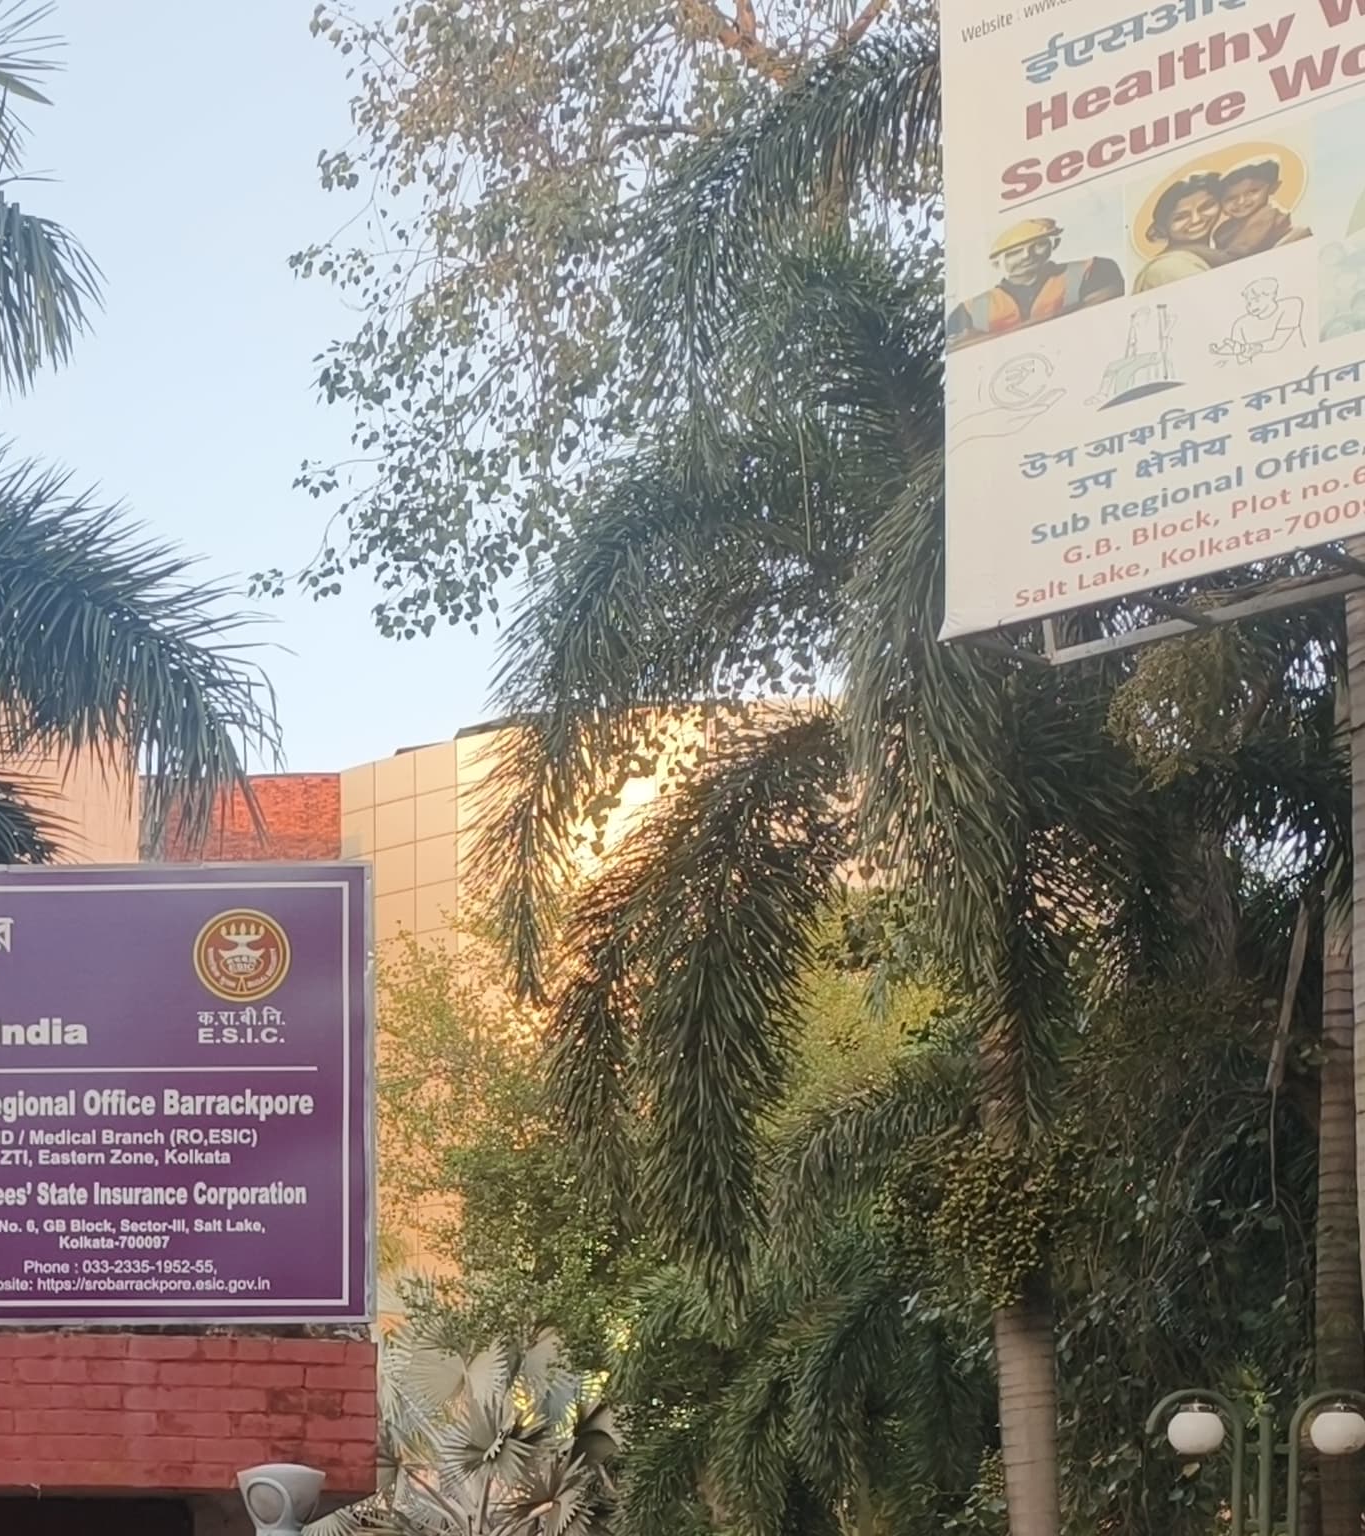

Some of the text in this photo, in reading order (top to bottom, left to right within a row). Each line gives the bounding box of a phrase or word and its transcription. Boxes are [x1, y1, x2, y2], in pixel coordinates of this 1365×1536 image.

[961, 12, 1014, 43] Website
[1026, 13, 1296, 141] Healthy
[1000, 90, 1246, 201] Secure
[1019, 446, 1079, 479] উপ
[1068, 434, 1233, 499] उप क्षेत्रीय
[1030, 465, 1244, 545] Sub Regional
[1063, 536, 1121, 565] G.B.
[1132, 508, 1220, 547] Block,
[1231, 487, 1292, 519] Plot
[1015, 560, 1150, 608] Salt Lake,
[197, 1026, 286, 1044] E.S.I.C.
[83, 1088, 157, 1117] Office
[164, 1088, 315, 1122] Barrackpore
[18, 1129, 25, 1146] /
[29, 1128, 97, 1146] Medical
[102, 1128, 165, 1146] Branch
[170, 1127, 258, 1148] (RO,ESIC)
[0, 1148, 232, 1168] ZTI, Eastern Zone, Kolkata
[37, 1181, 89, 1207] State
[94, 1181, 188, 1206] Insurance
[193, 1180, 308, 1211] Corporation
[26, 1218, 40, 1235] 6,
[43, 1218, 67, 1233] GB
[70, 1218, 117, 1235] Block,
[120, 1218, 190, 1235] Sector-III,
[193, 1218, 223, 1233] Salt
[226, 1218, 266, 1235] Lake,
[59, 1235, 170, 1250] Kolkata-700097
[24, 1259, 218, 1276] Phone 033-2335-1952-55,
[37, 1275, 271, 1294] https://srobarrackpore.esic.gov.in
